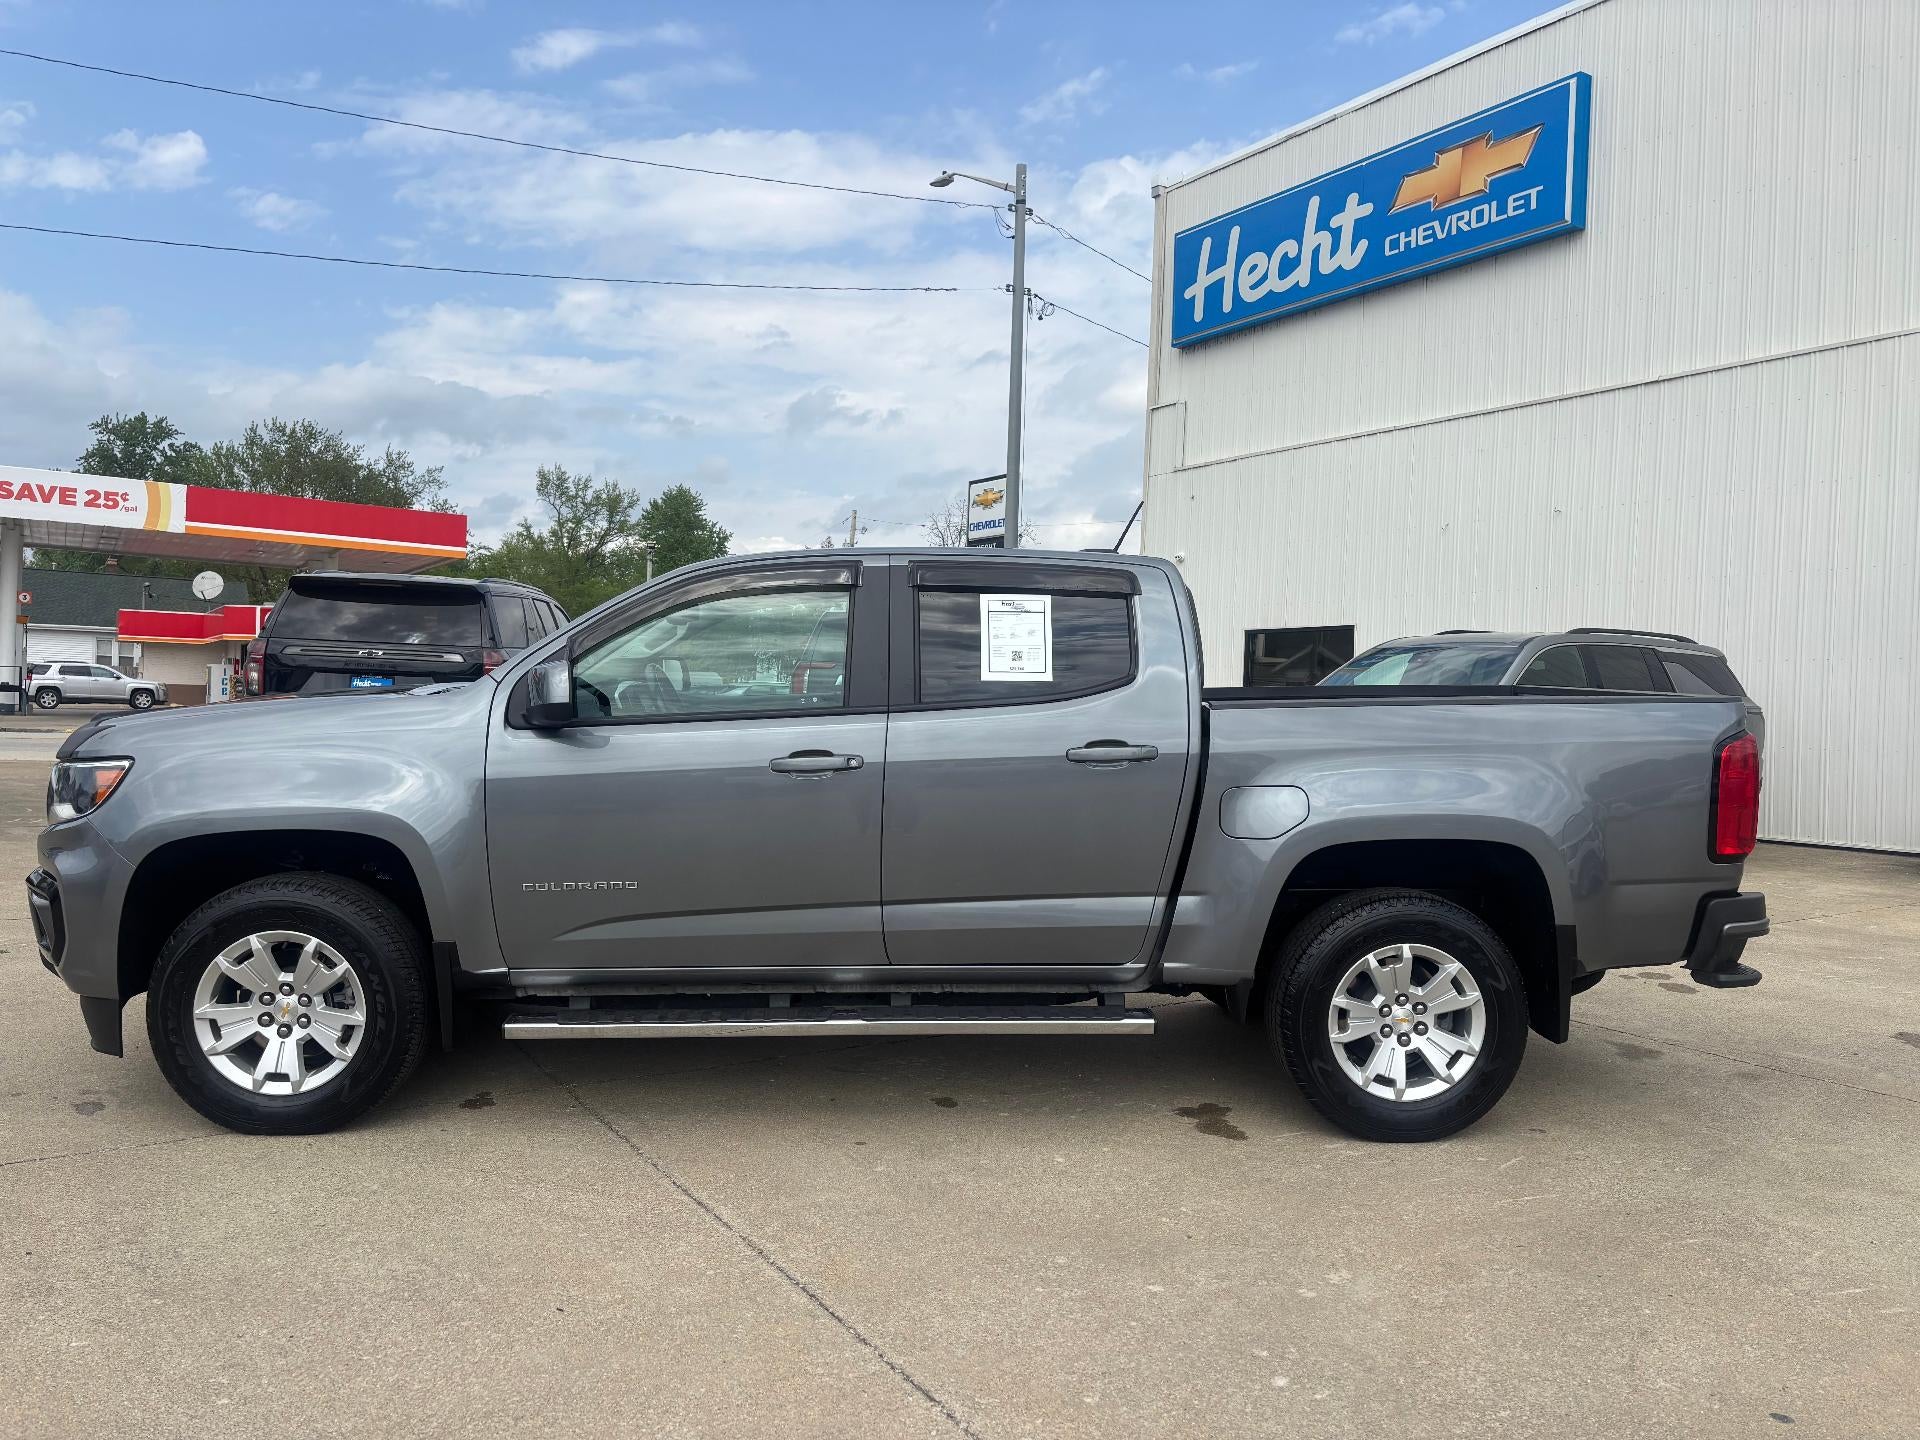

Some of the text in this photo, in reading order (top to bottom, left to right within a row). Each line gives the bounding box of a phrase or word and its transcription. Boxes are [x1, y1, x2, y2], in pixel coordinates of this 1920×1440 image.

[1383, 184, 1544, 257] CHEVROLET
[1183, 191, 1374, 323] Hecht
[0, 480, 78, 507] SAVE
[969, 518, 1006, 532] CHEVROLET
[521, 881, 639, 892] COLORADO
